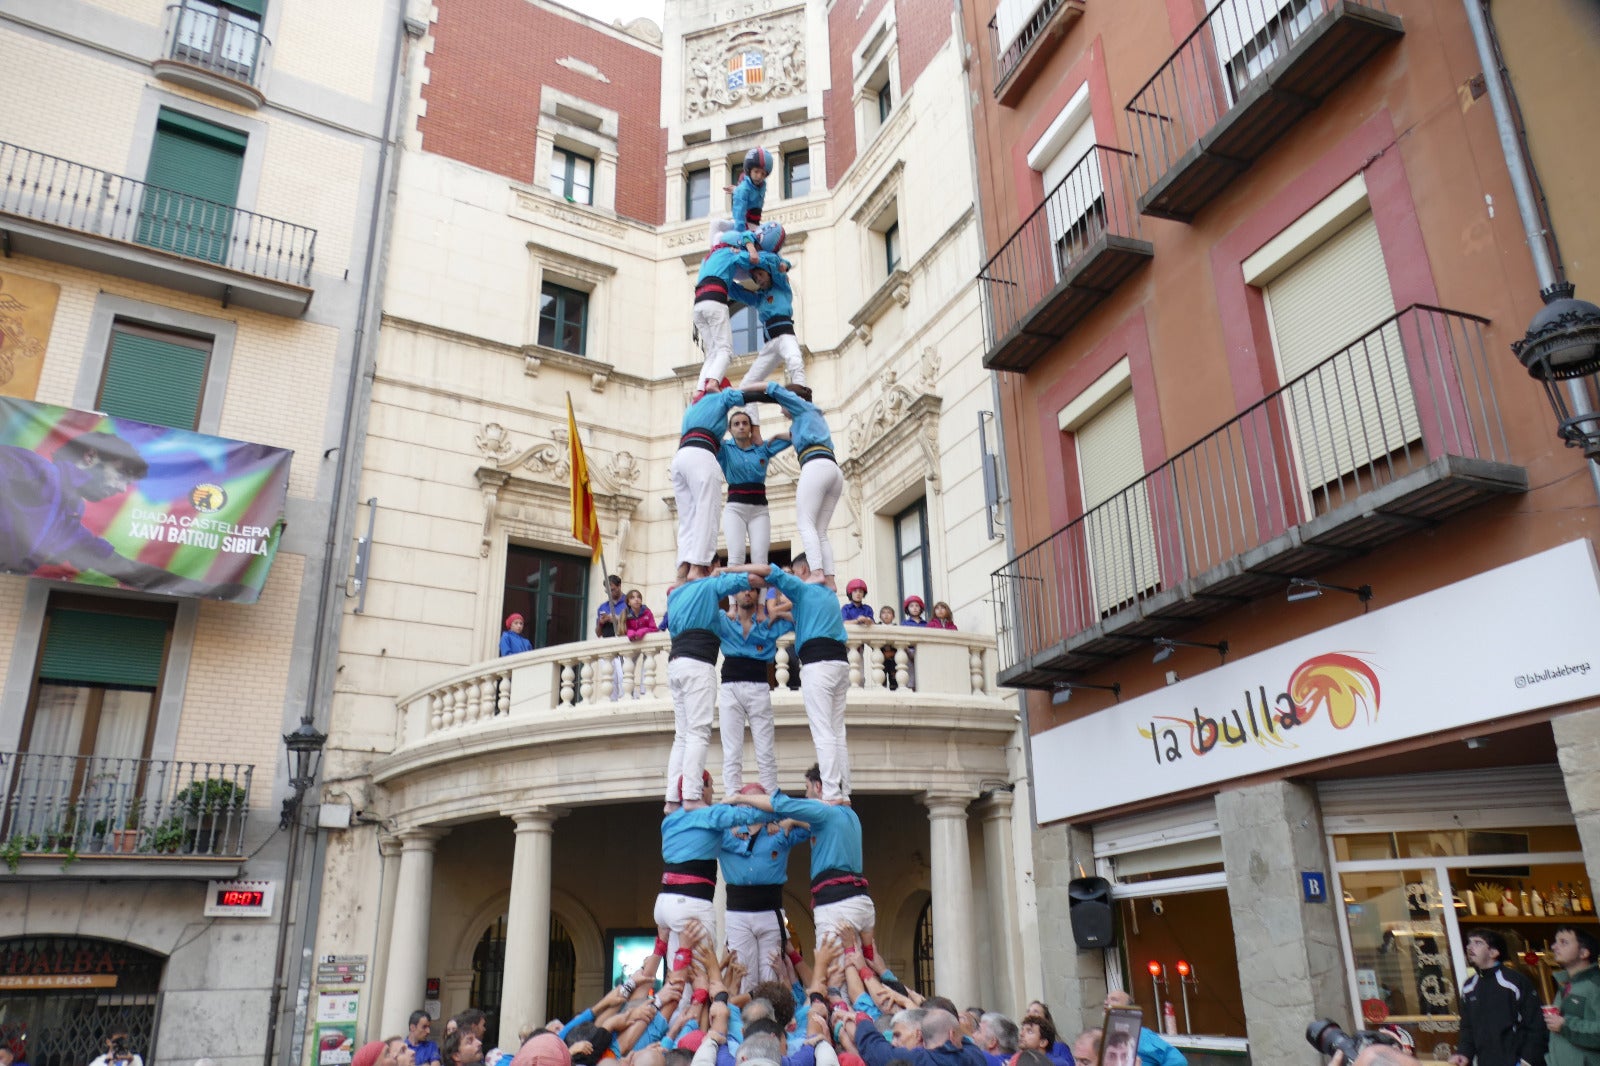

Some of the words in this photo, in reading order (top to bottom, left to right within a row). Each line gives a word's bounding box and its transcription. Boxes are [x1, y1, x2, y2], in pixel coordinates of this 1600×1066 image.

[131, 508, 178, 525] DIADA
[180, 516, 271, 538] CASTELLERA
[129, 522, 165, 541] XAVI
[167, 527, 220, 550] BATRIU
[221, 536, 268, 556] SIBILA
[1526, 662, 1591, 684] labulladeberga
[1150, 722, 1183, 765] la
[1193, 685, 1302, 754] bulla
[1308, 878, 1320, 896] B
[223, 891, 262, 906] 18:07
[0, 951, 115, 974] DALBA
[38, 976, 52, 985] LA
